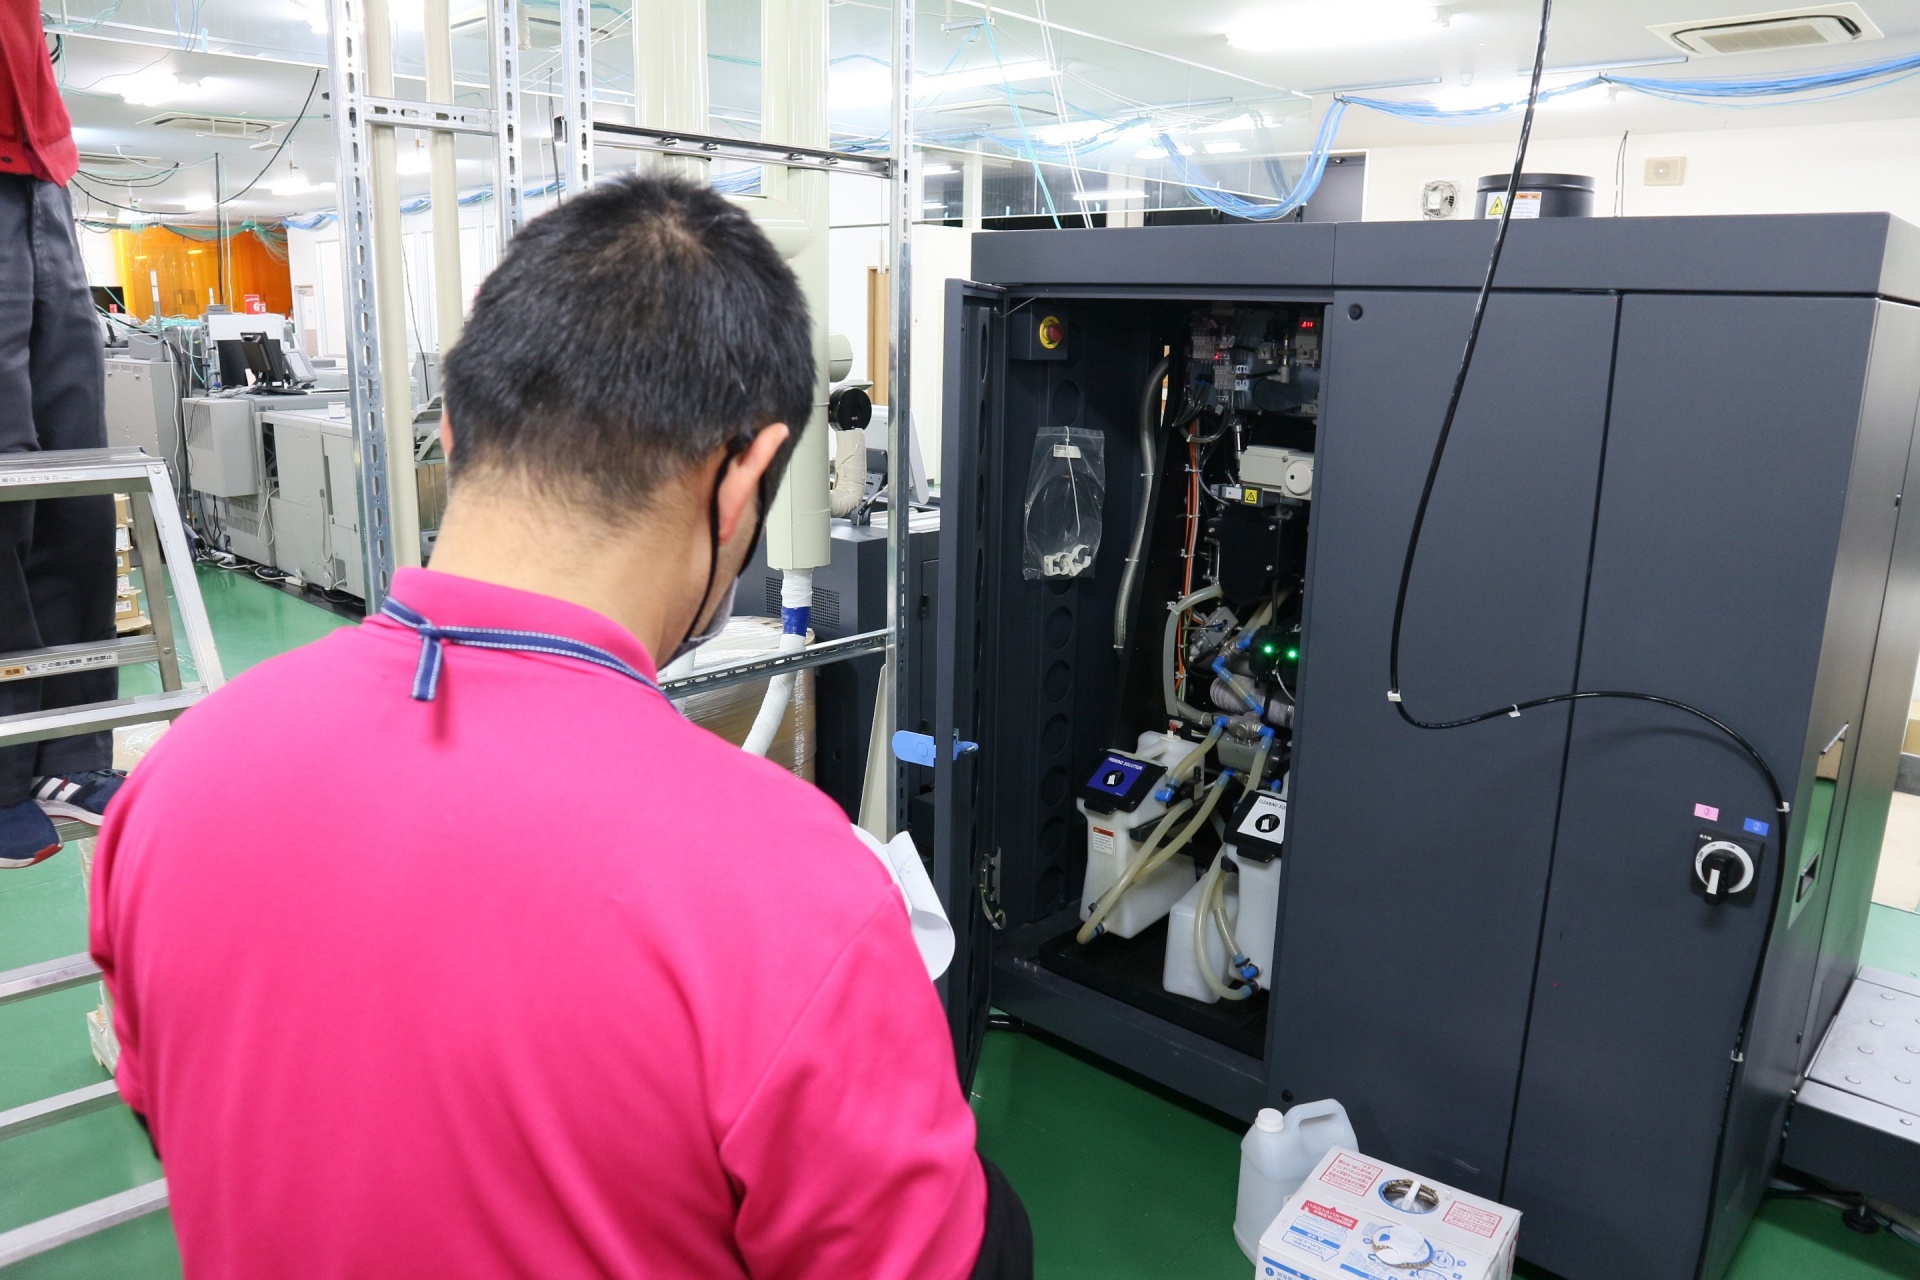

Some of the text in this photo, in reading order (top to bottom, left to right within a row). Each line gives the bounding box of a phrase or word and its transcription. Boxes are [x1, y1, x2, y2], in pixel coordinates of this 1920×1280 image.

[86, 654, 112, 662] 使用禁止
[1125, 760, 1142, 771] SOLUTION
